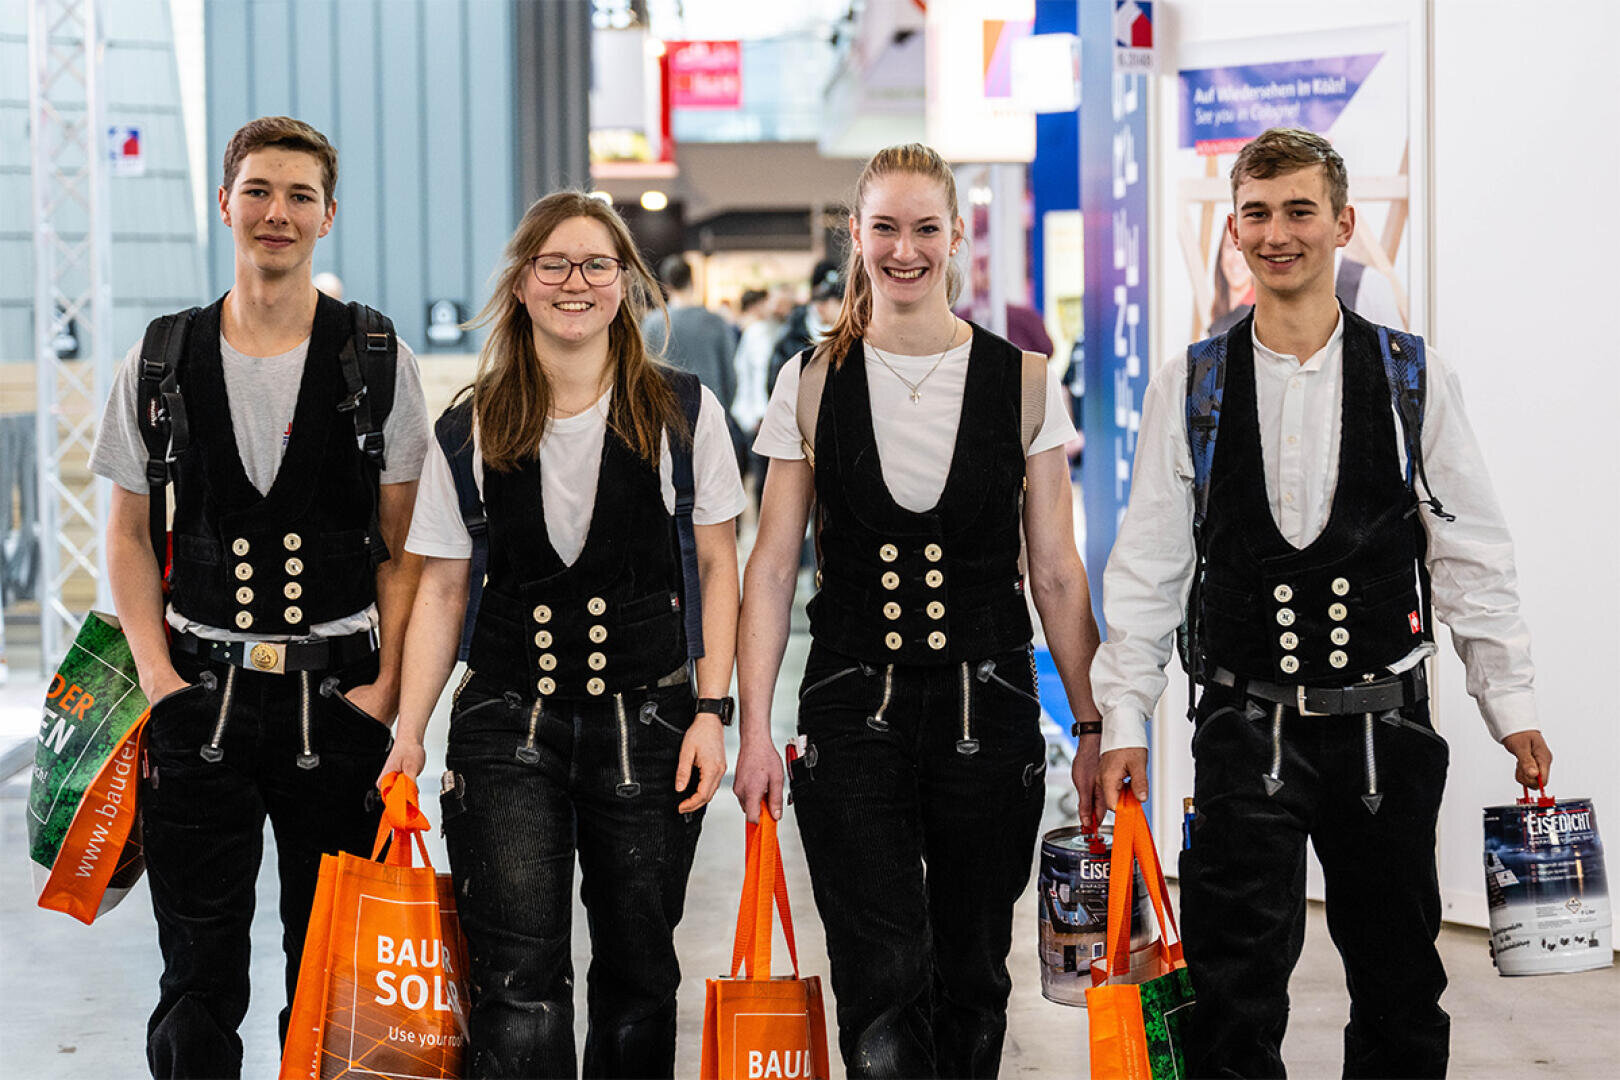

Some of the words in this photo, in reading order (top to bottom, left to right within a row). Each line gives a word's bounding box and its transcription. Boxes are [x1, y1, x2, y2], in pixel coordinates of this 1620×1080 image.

[1193, 87, 1216, 104] Auf
[1217, 81, 1296, 102] Wiedersehen
[1195, 107, 1213, 125] See
[1214, 108, 1235, 127] you
[1526, 811, 1592, 836] EISEDICHT
[389, 1026, 416, 1043] Use
[418, 1033, 448, 1048] your
